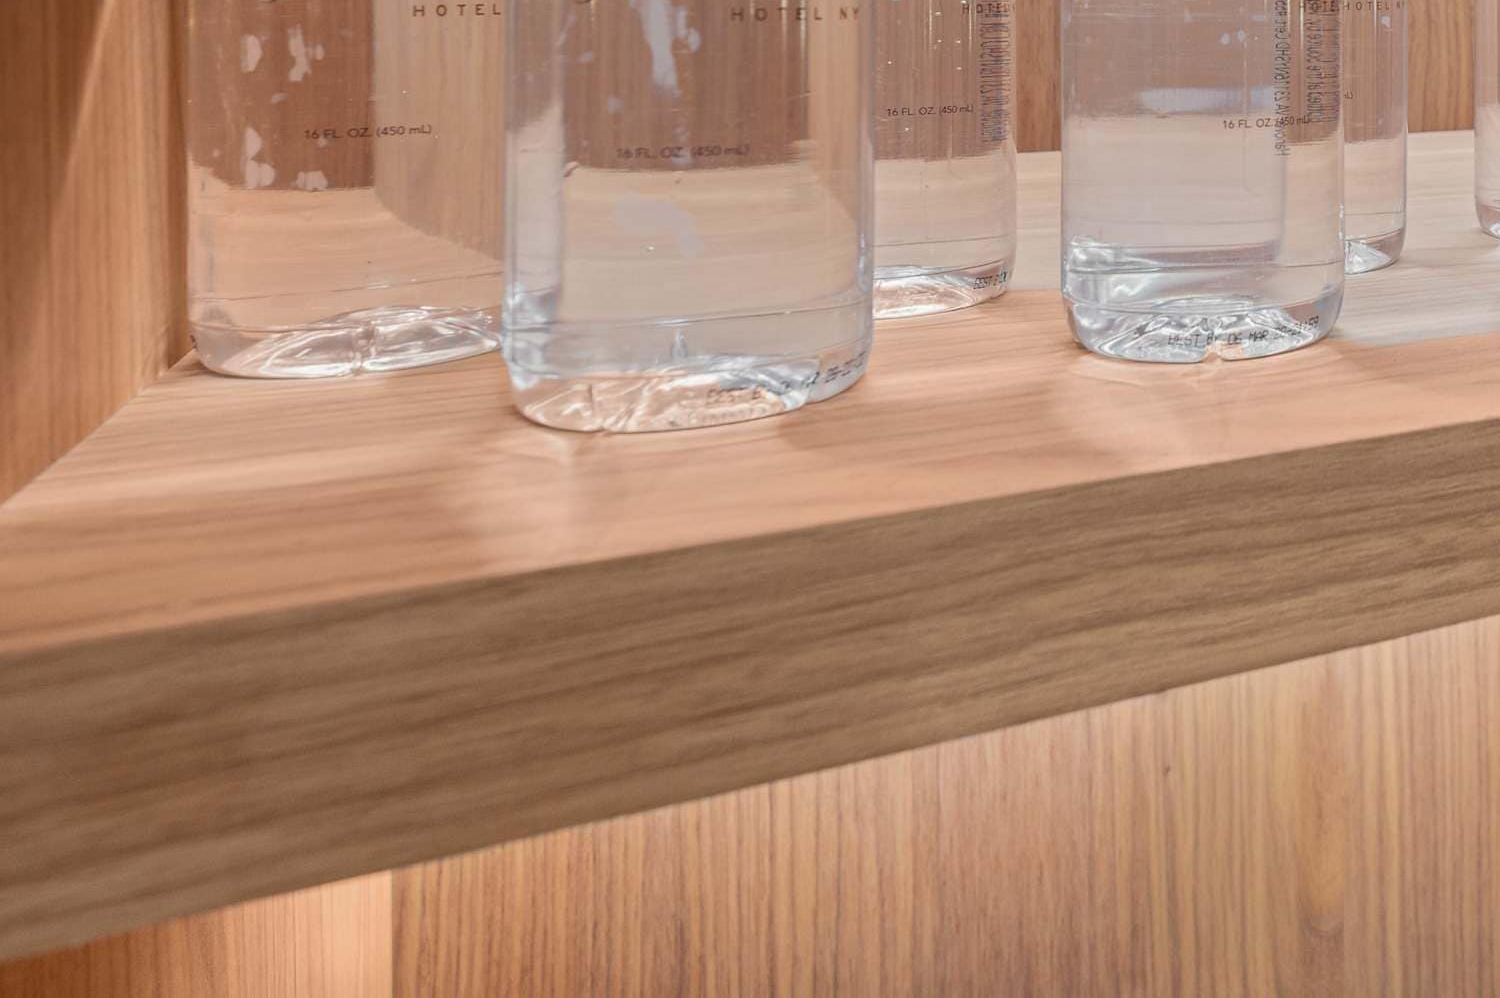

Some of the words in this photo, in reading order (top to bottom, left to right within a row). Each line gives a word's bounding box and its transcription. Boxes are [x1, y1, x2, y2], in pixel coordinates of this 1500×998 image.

[412, 3, 503, 17] HOTEL
[731, 7, 822, 22] HOTEL
[1223, 119, 1236, 130] 16
